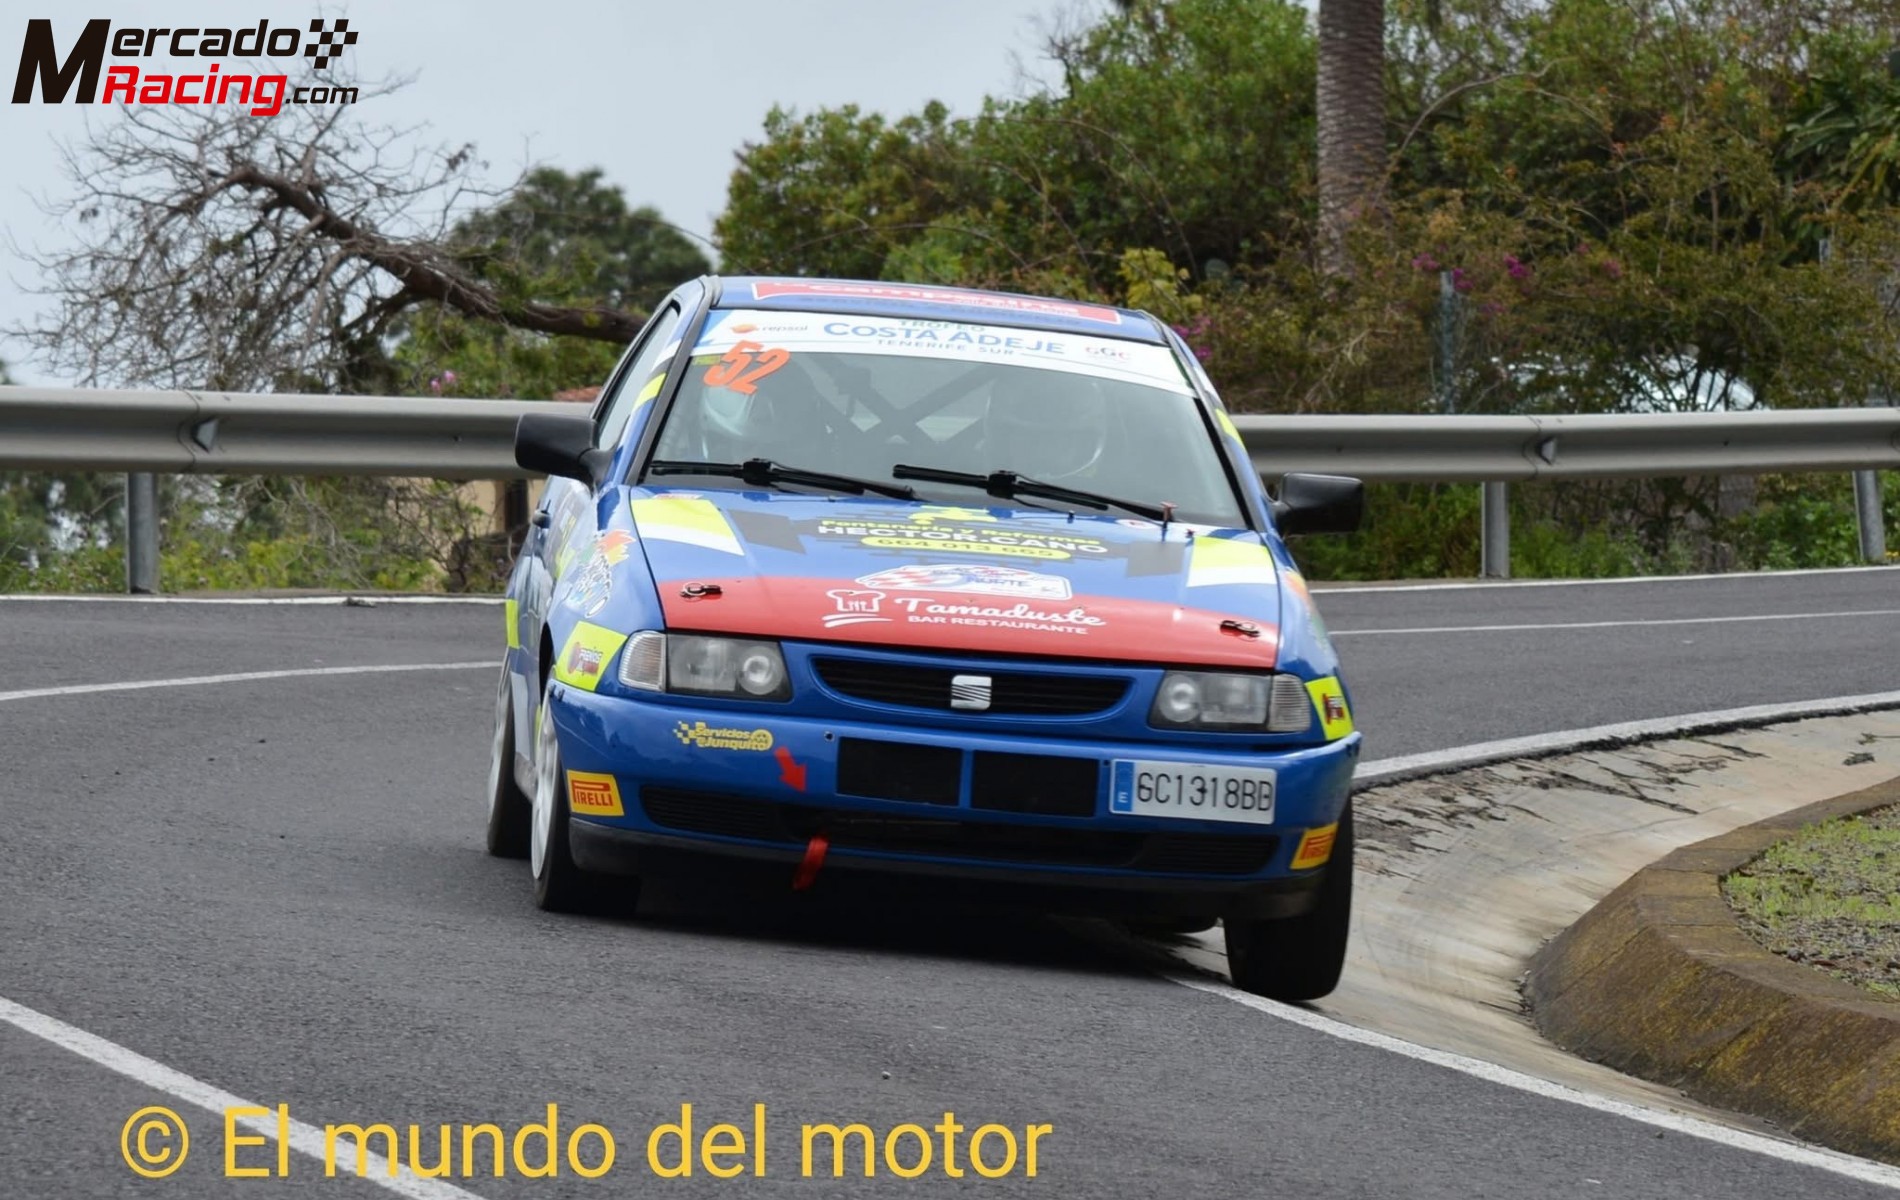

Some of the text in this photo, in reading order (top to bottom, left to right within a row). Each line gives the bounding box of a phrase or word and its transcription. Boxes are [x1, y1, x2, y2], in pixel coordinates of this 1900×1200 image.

[762, 325, 808, 333] repsol
[824, 323, 1066, 354] COSTA ADEJE
[877, 339, 1015, 356] TENERIFE SUR
[703, 340, 790, 395] 52
[895, 596, 1108, 627] Tamaduste
[908, 615, 1089, 635] BAR RESTAURANTE
[571, 779, 614, 807] PIRELLI
